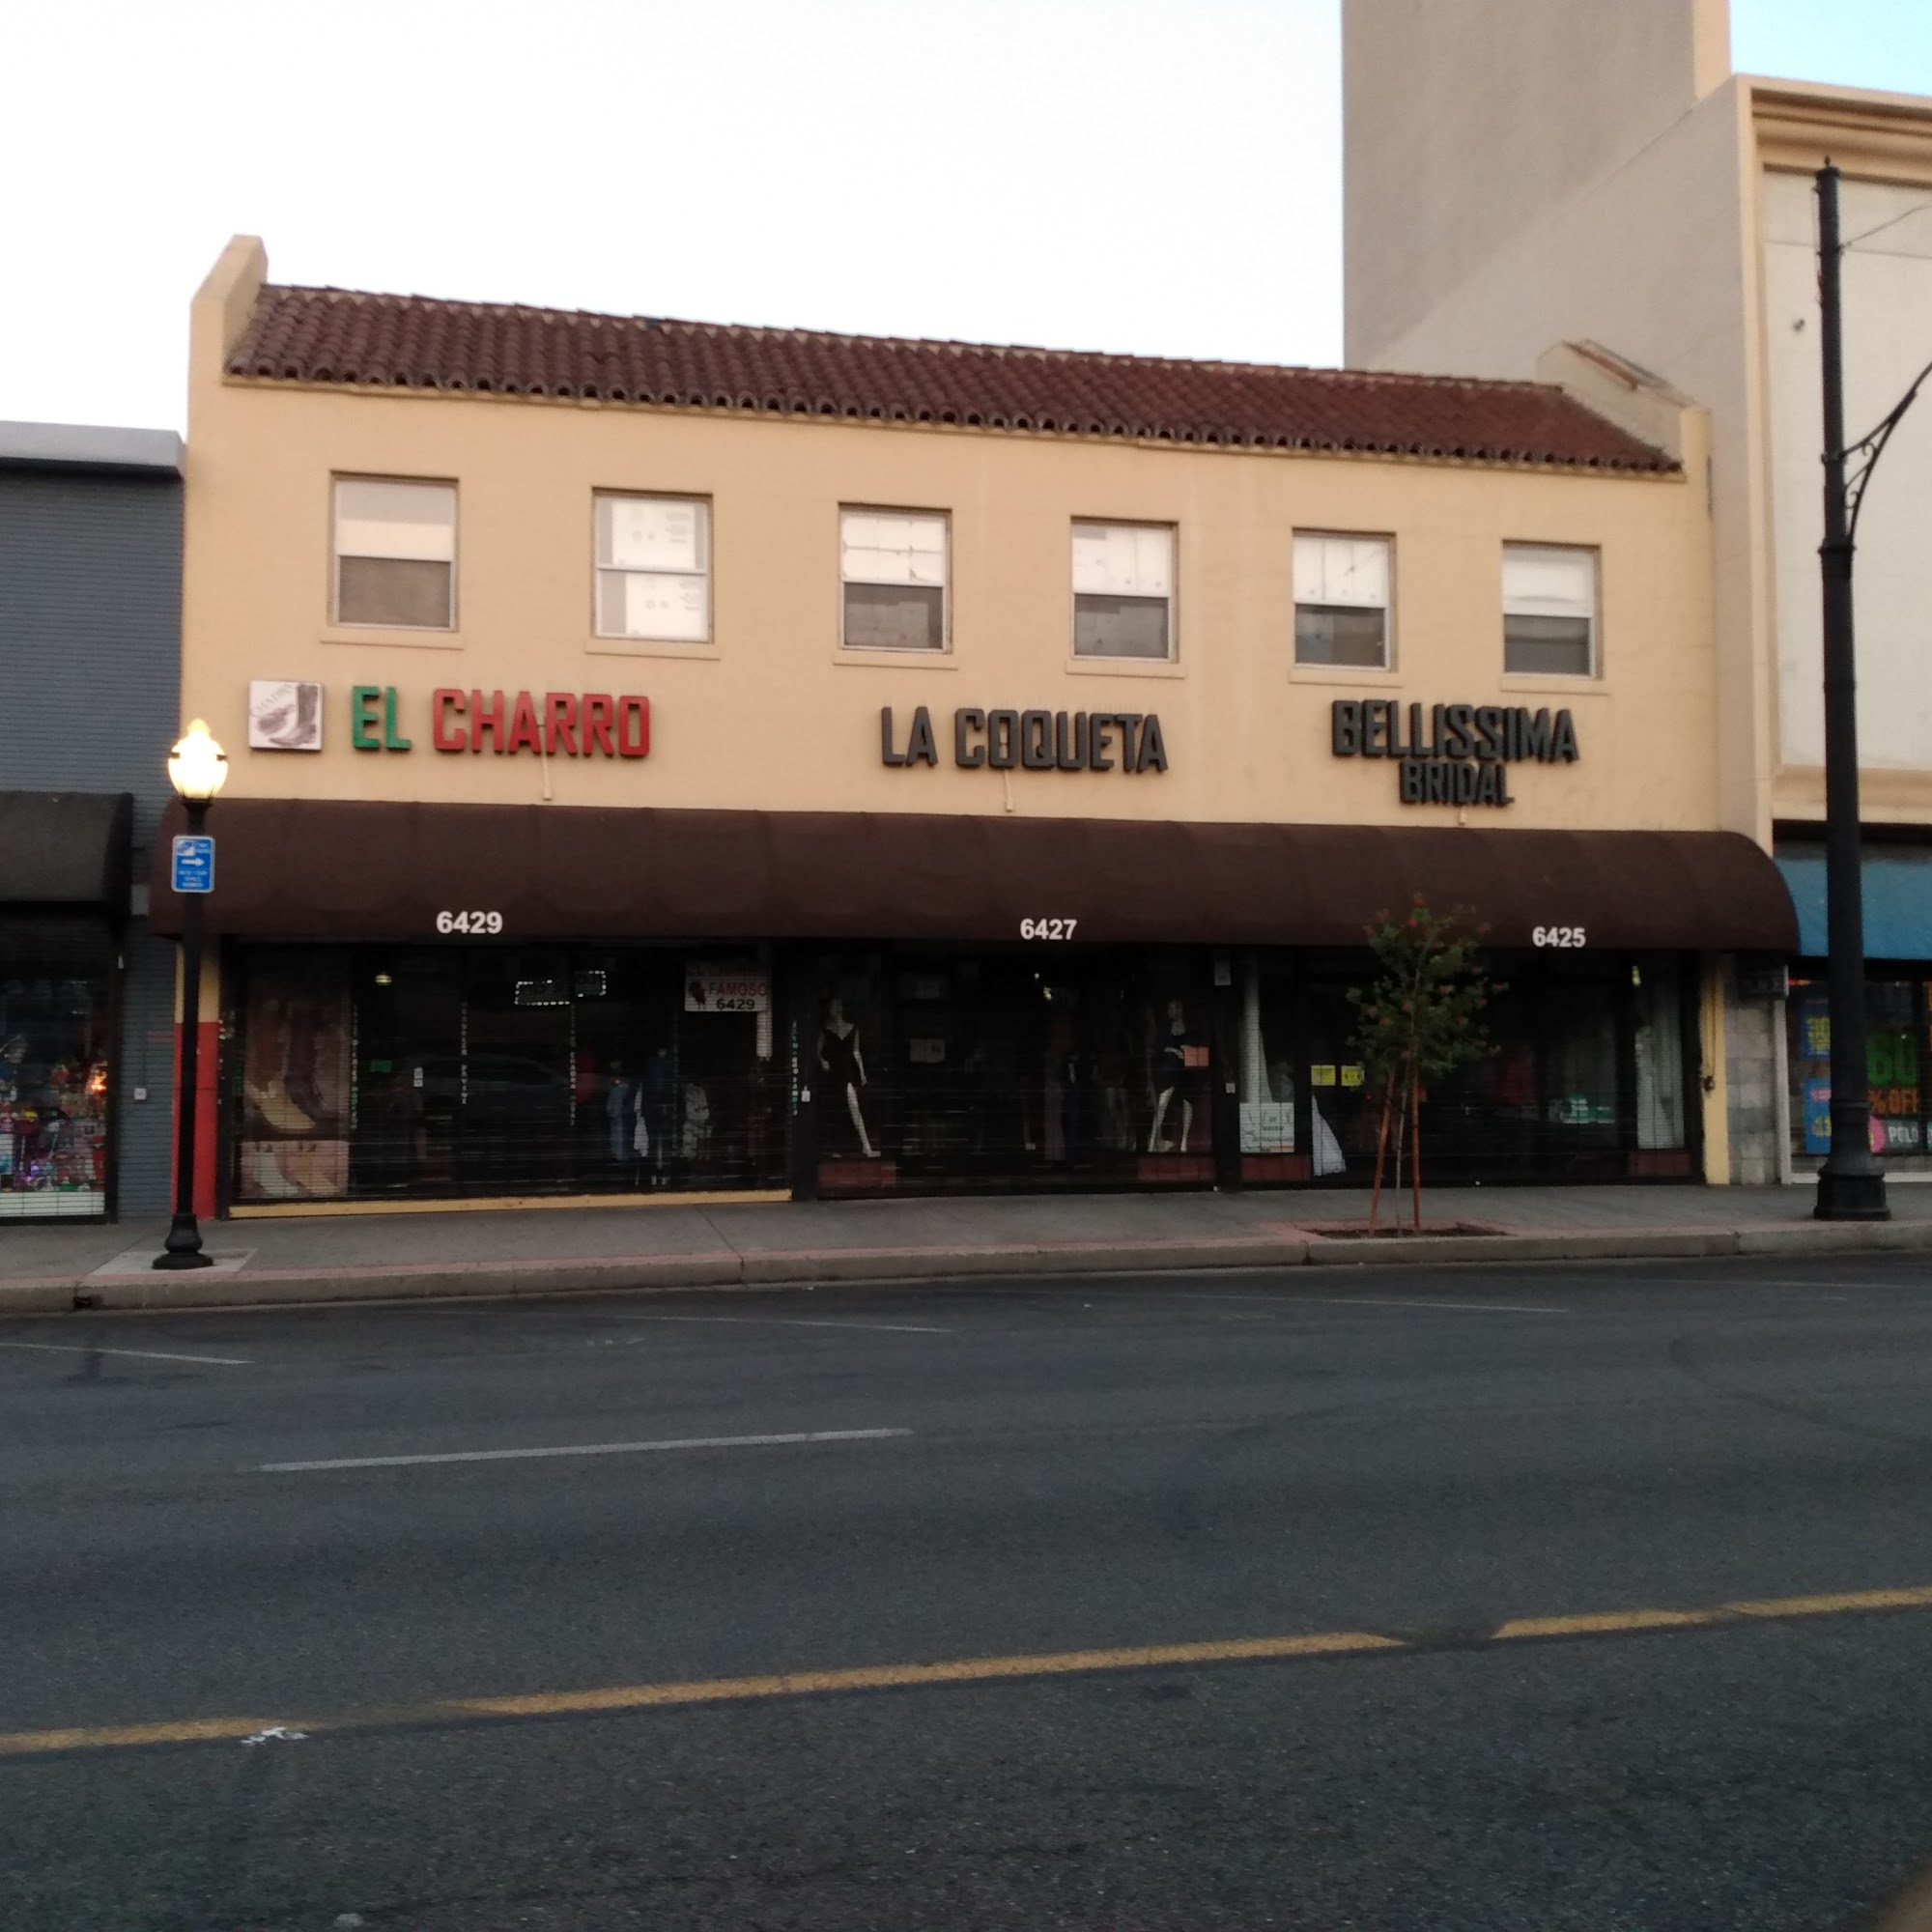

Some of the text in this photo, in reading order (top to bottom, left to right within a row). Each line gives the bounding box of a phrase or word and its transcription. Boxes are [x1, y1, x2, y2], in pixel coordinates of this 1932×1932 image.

[352, 685, 412, 751] EL
[433, 688, 651, 757] CHARRO
[1331, 699, 1580, 764] BELLISSIMA
[880, 706, 1169, 774] LA COQUETA
[1398, 760, 1516, 808] BRIDAL
[436, 910, 503, 934] 6429
[1019, 918, 1078, 941] 6427
[1532, 925, 1587, 949] 6425
[716, 998, 755, 1010] 6429
